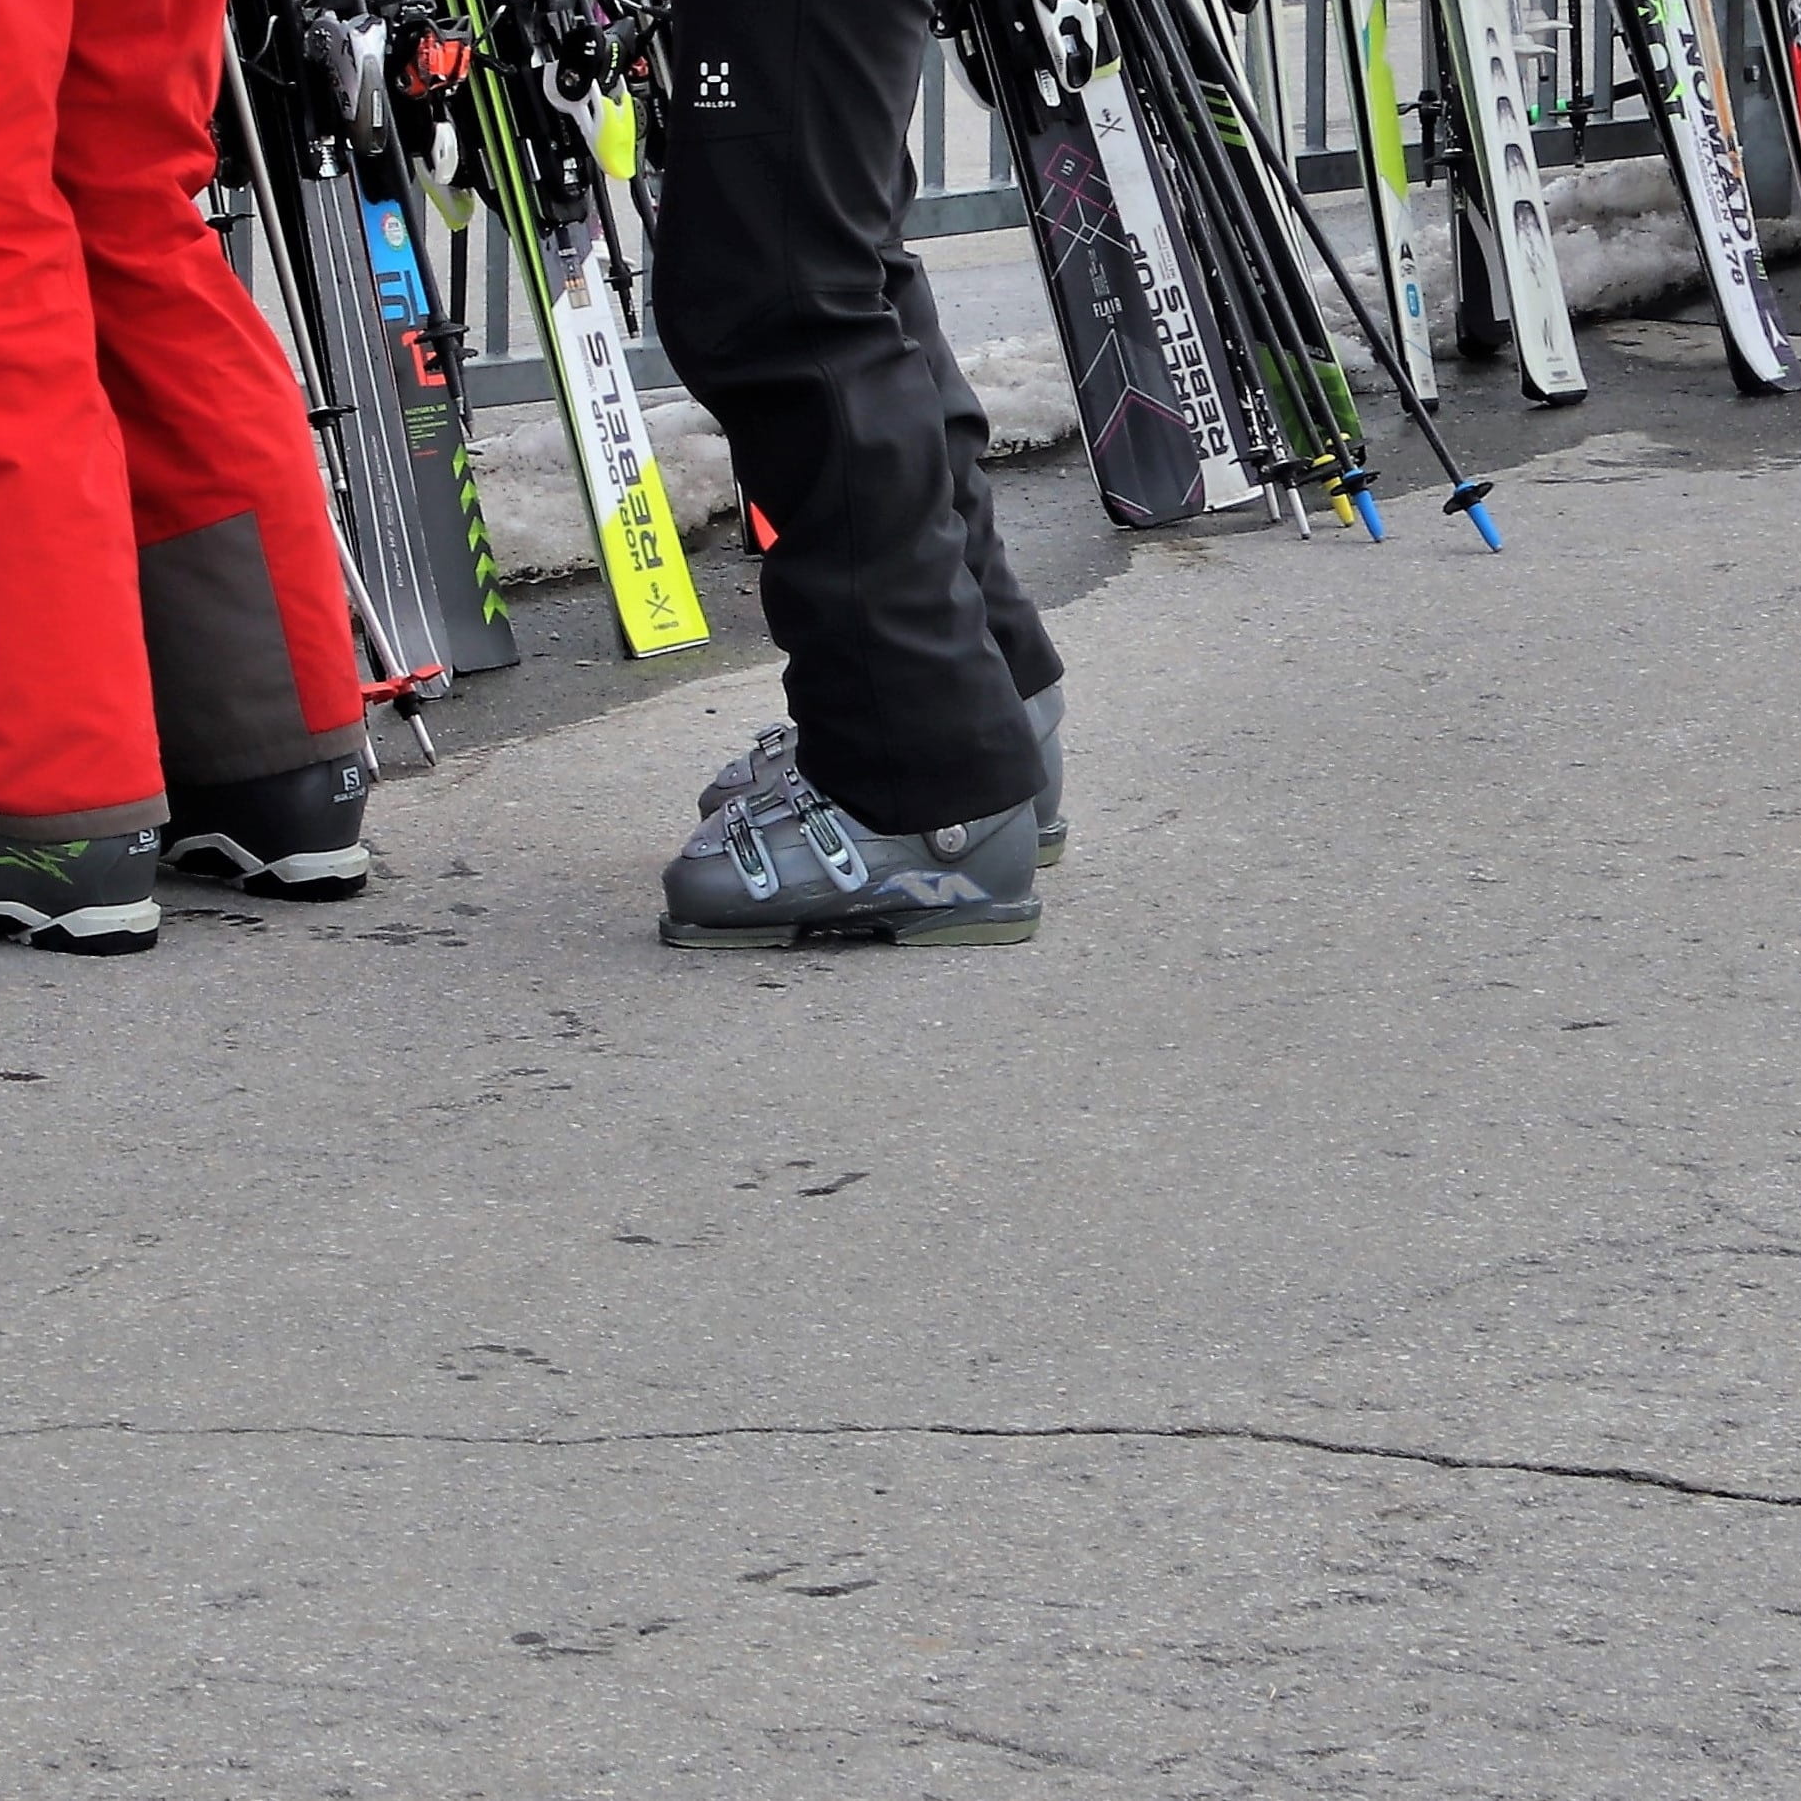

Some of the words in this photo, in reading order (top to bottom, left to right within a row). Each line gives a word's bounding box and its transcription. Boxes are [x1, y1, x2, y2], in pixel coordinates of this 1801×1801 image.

[1679, 27, 1752, 242] NOMAD
[1720, 225, 1746, 287] 178
[590, 329, 664, 570] REBELS
[1164, 284, 1229, 458] REBELS
[593, 399, 646, 572] WORLDCUP
